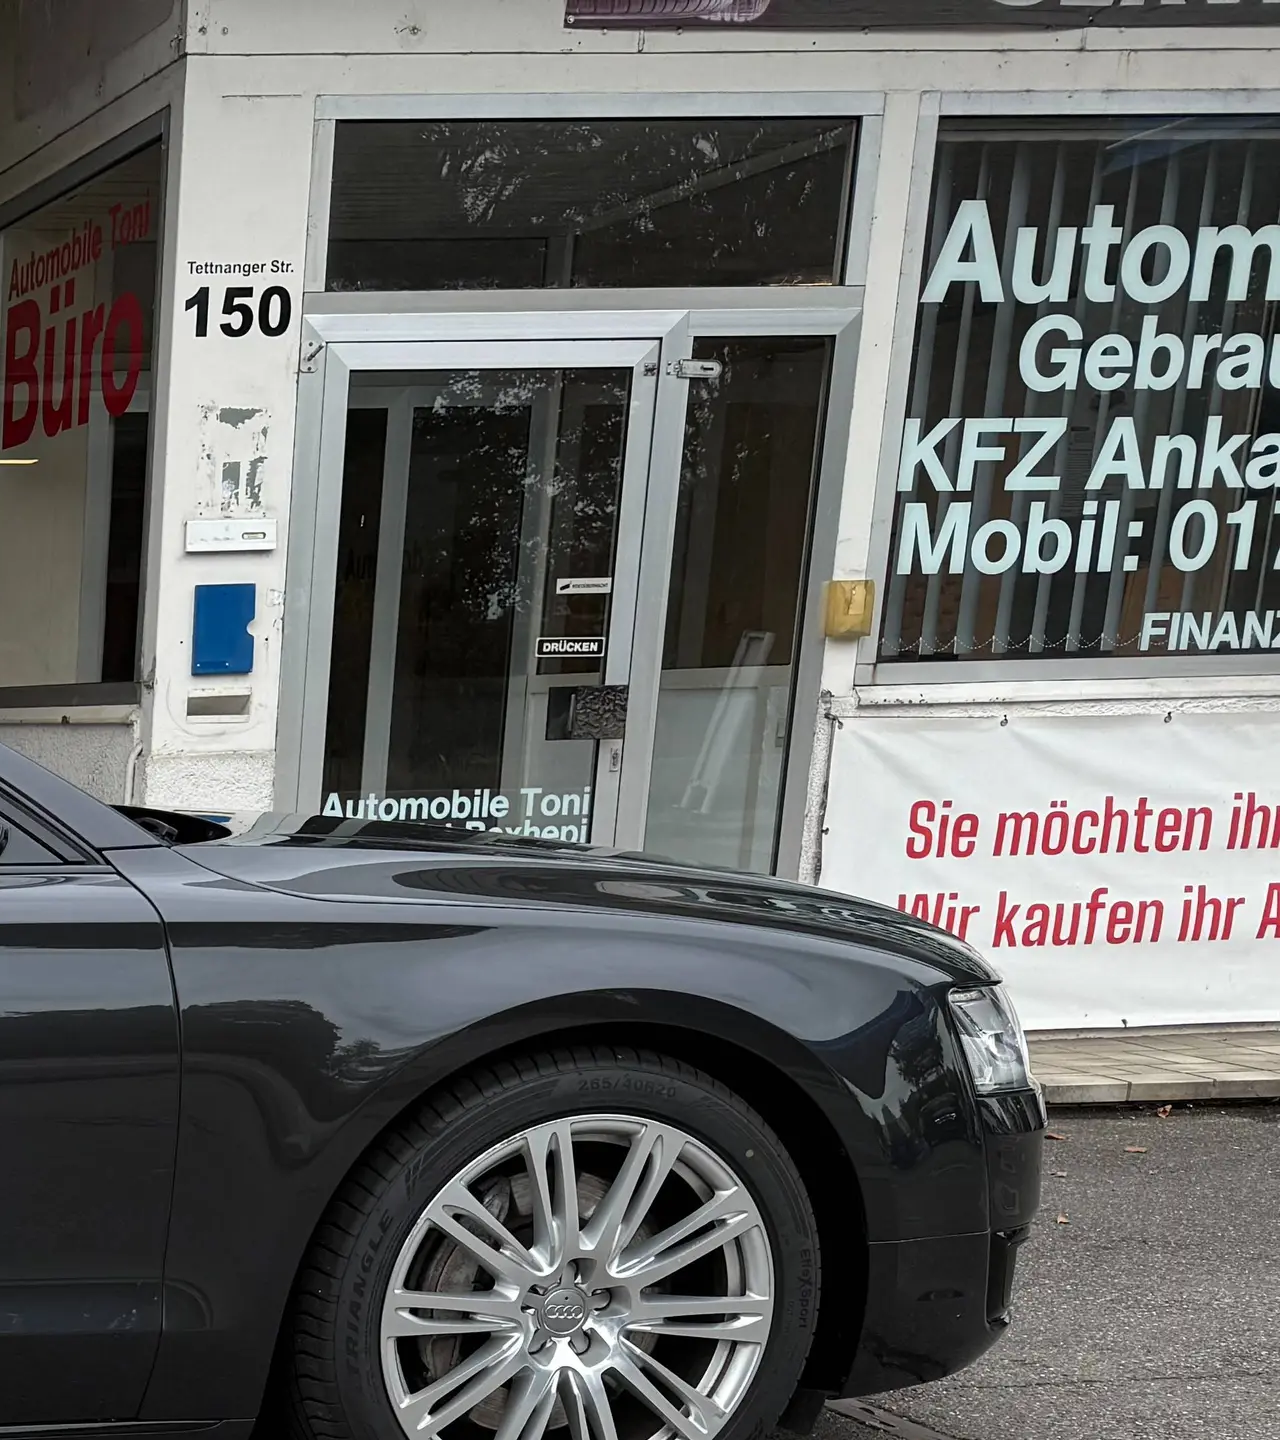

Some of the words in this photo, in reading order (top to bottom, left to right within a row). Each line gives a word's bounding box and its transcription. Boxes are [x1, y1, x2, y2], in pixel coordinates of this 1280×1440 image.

[8, 218, 102, 302] Automobile
[108, 190, 151, 249] Toni
[187, 261, 267, 277] Tettnanger
[270, 259, 294, 273] Str.
[185, 285, 292, 337] 150
[2, 278, 144, 450] Büro
[1019, 313, 1280, 393] Gebra
[896, 417, 1068, 492] KFZ
[1084, 415, 1280, 490] Anka
[896, 500, 1144, 576] Mobil:
[1169, 499, 1280, 572] 01
[542, 639, 598, 653] DRÜCKEN
[1140, 611, 1280, 651] FINAN
[321, 788, 509, 822] Automobile
[520, 786, 591, 817] Toni
[906, 800, 979, 860] Sie
[992, 795, 1214, 857] möchten
[992, 888, 1165, 948] kaufen
[1177, 885, 1246, 942] ihr
[345, 1207, 394, 1376] TRIANGLE
